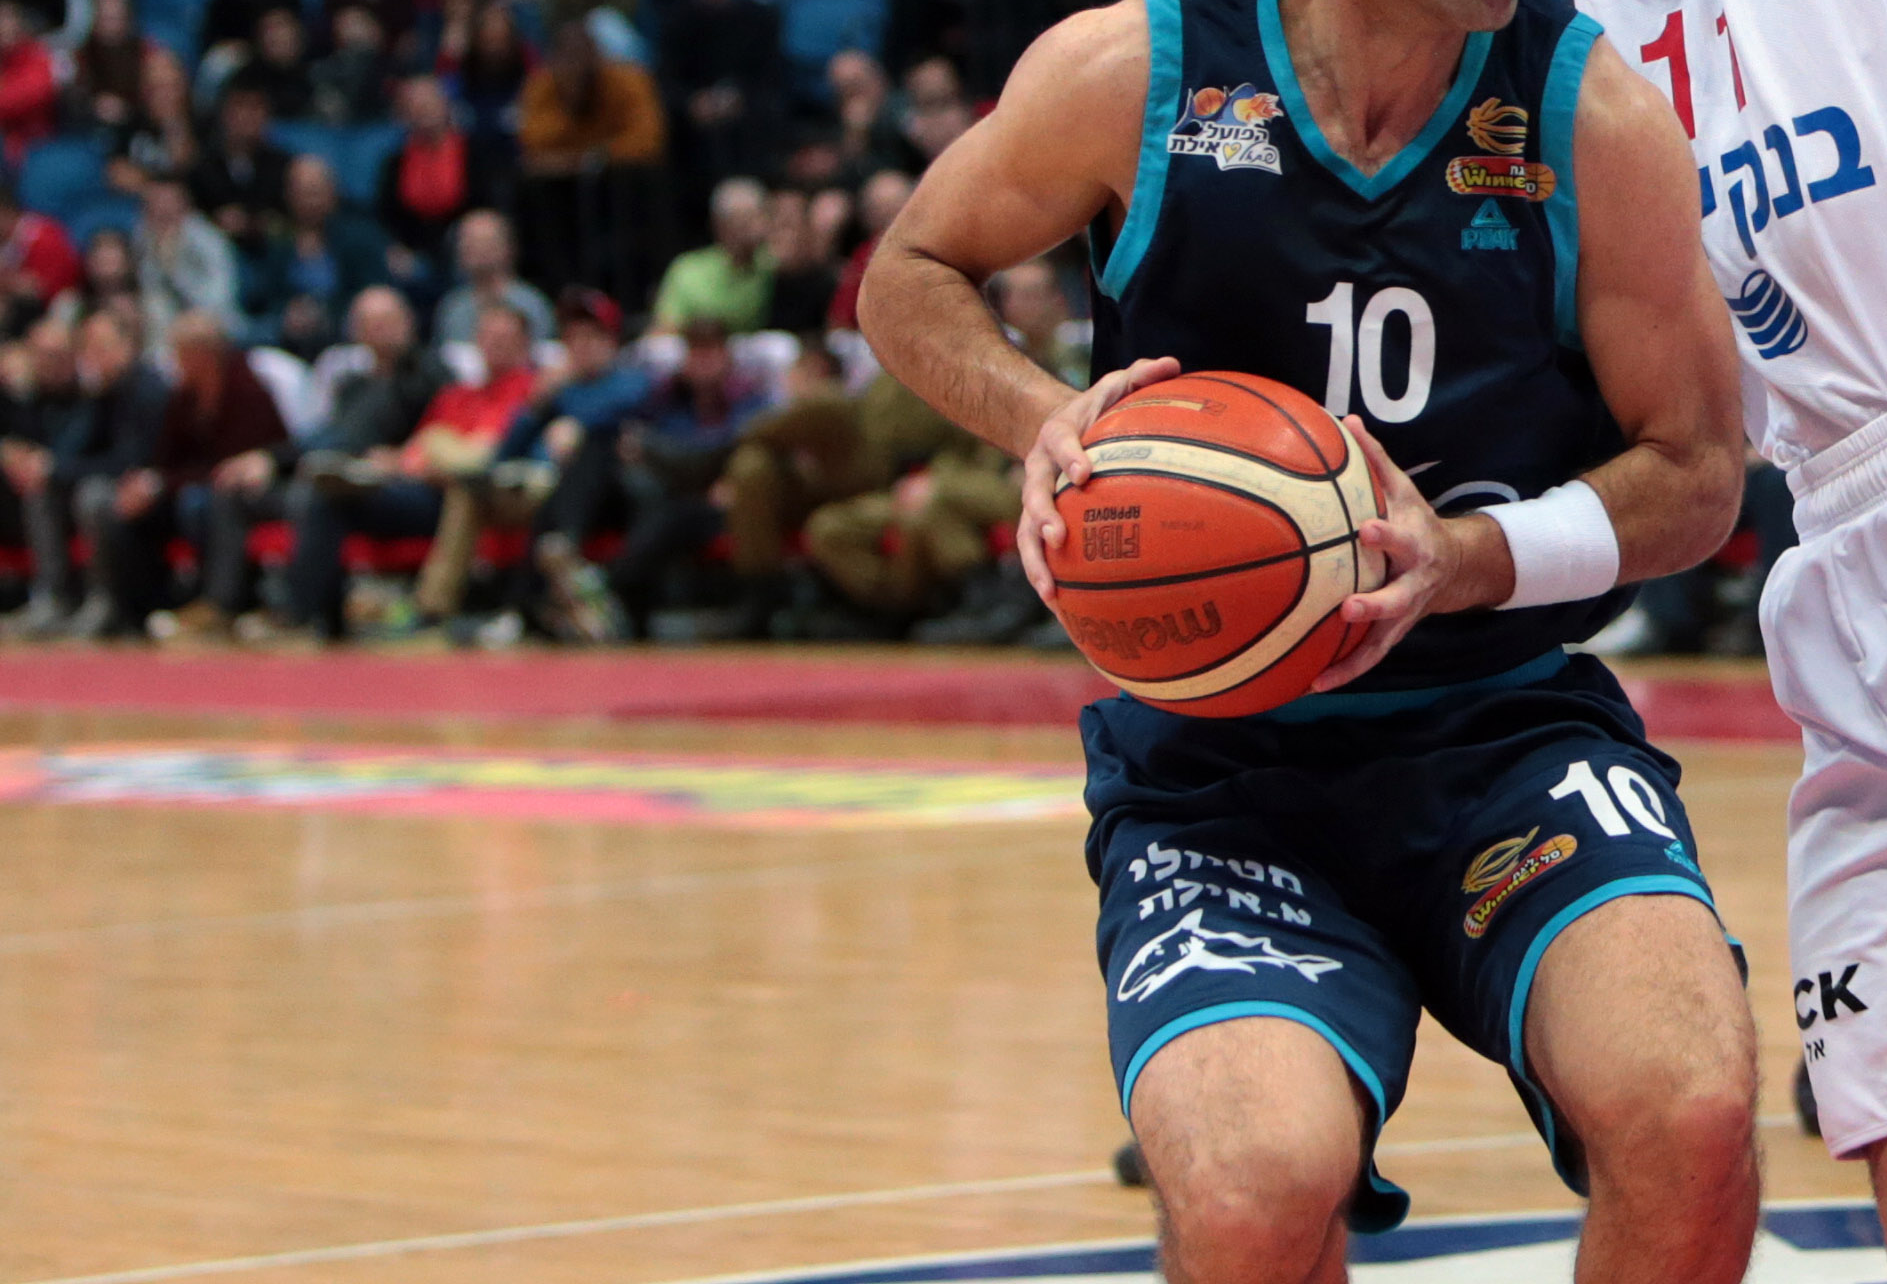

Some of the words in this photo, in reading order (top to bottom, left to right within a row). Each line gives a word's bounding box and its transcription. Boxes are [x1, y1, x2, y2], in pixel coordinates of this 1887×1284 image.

[1206, 122, 1267, 141] הפועל
[1169, 137, 1221, 154] אילת
[1461, 162, 1527, 189] Winne
[1461, 228, 1520, 250] PEAK
[1304, 281, 1437, 424] 10
[1082, 505, 1142, 522] APPROVED
[1082, 523, 1141, 562] FIBA
[1548, 760, 1678, 841] 10
[1473, 861, 1540, 925] Winner
